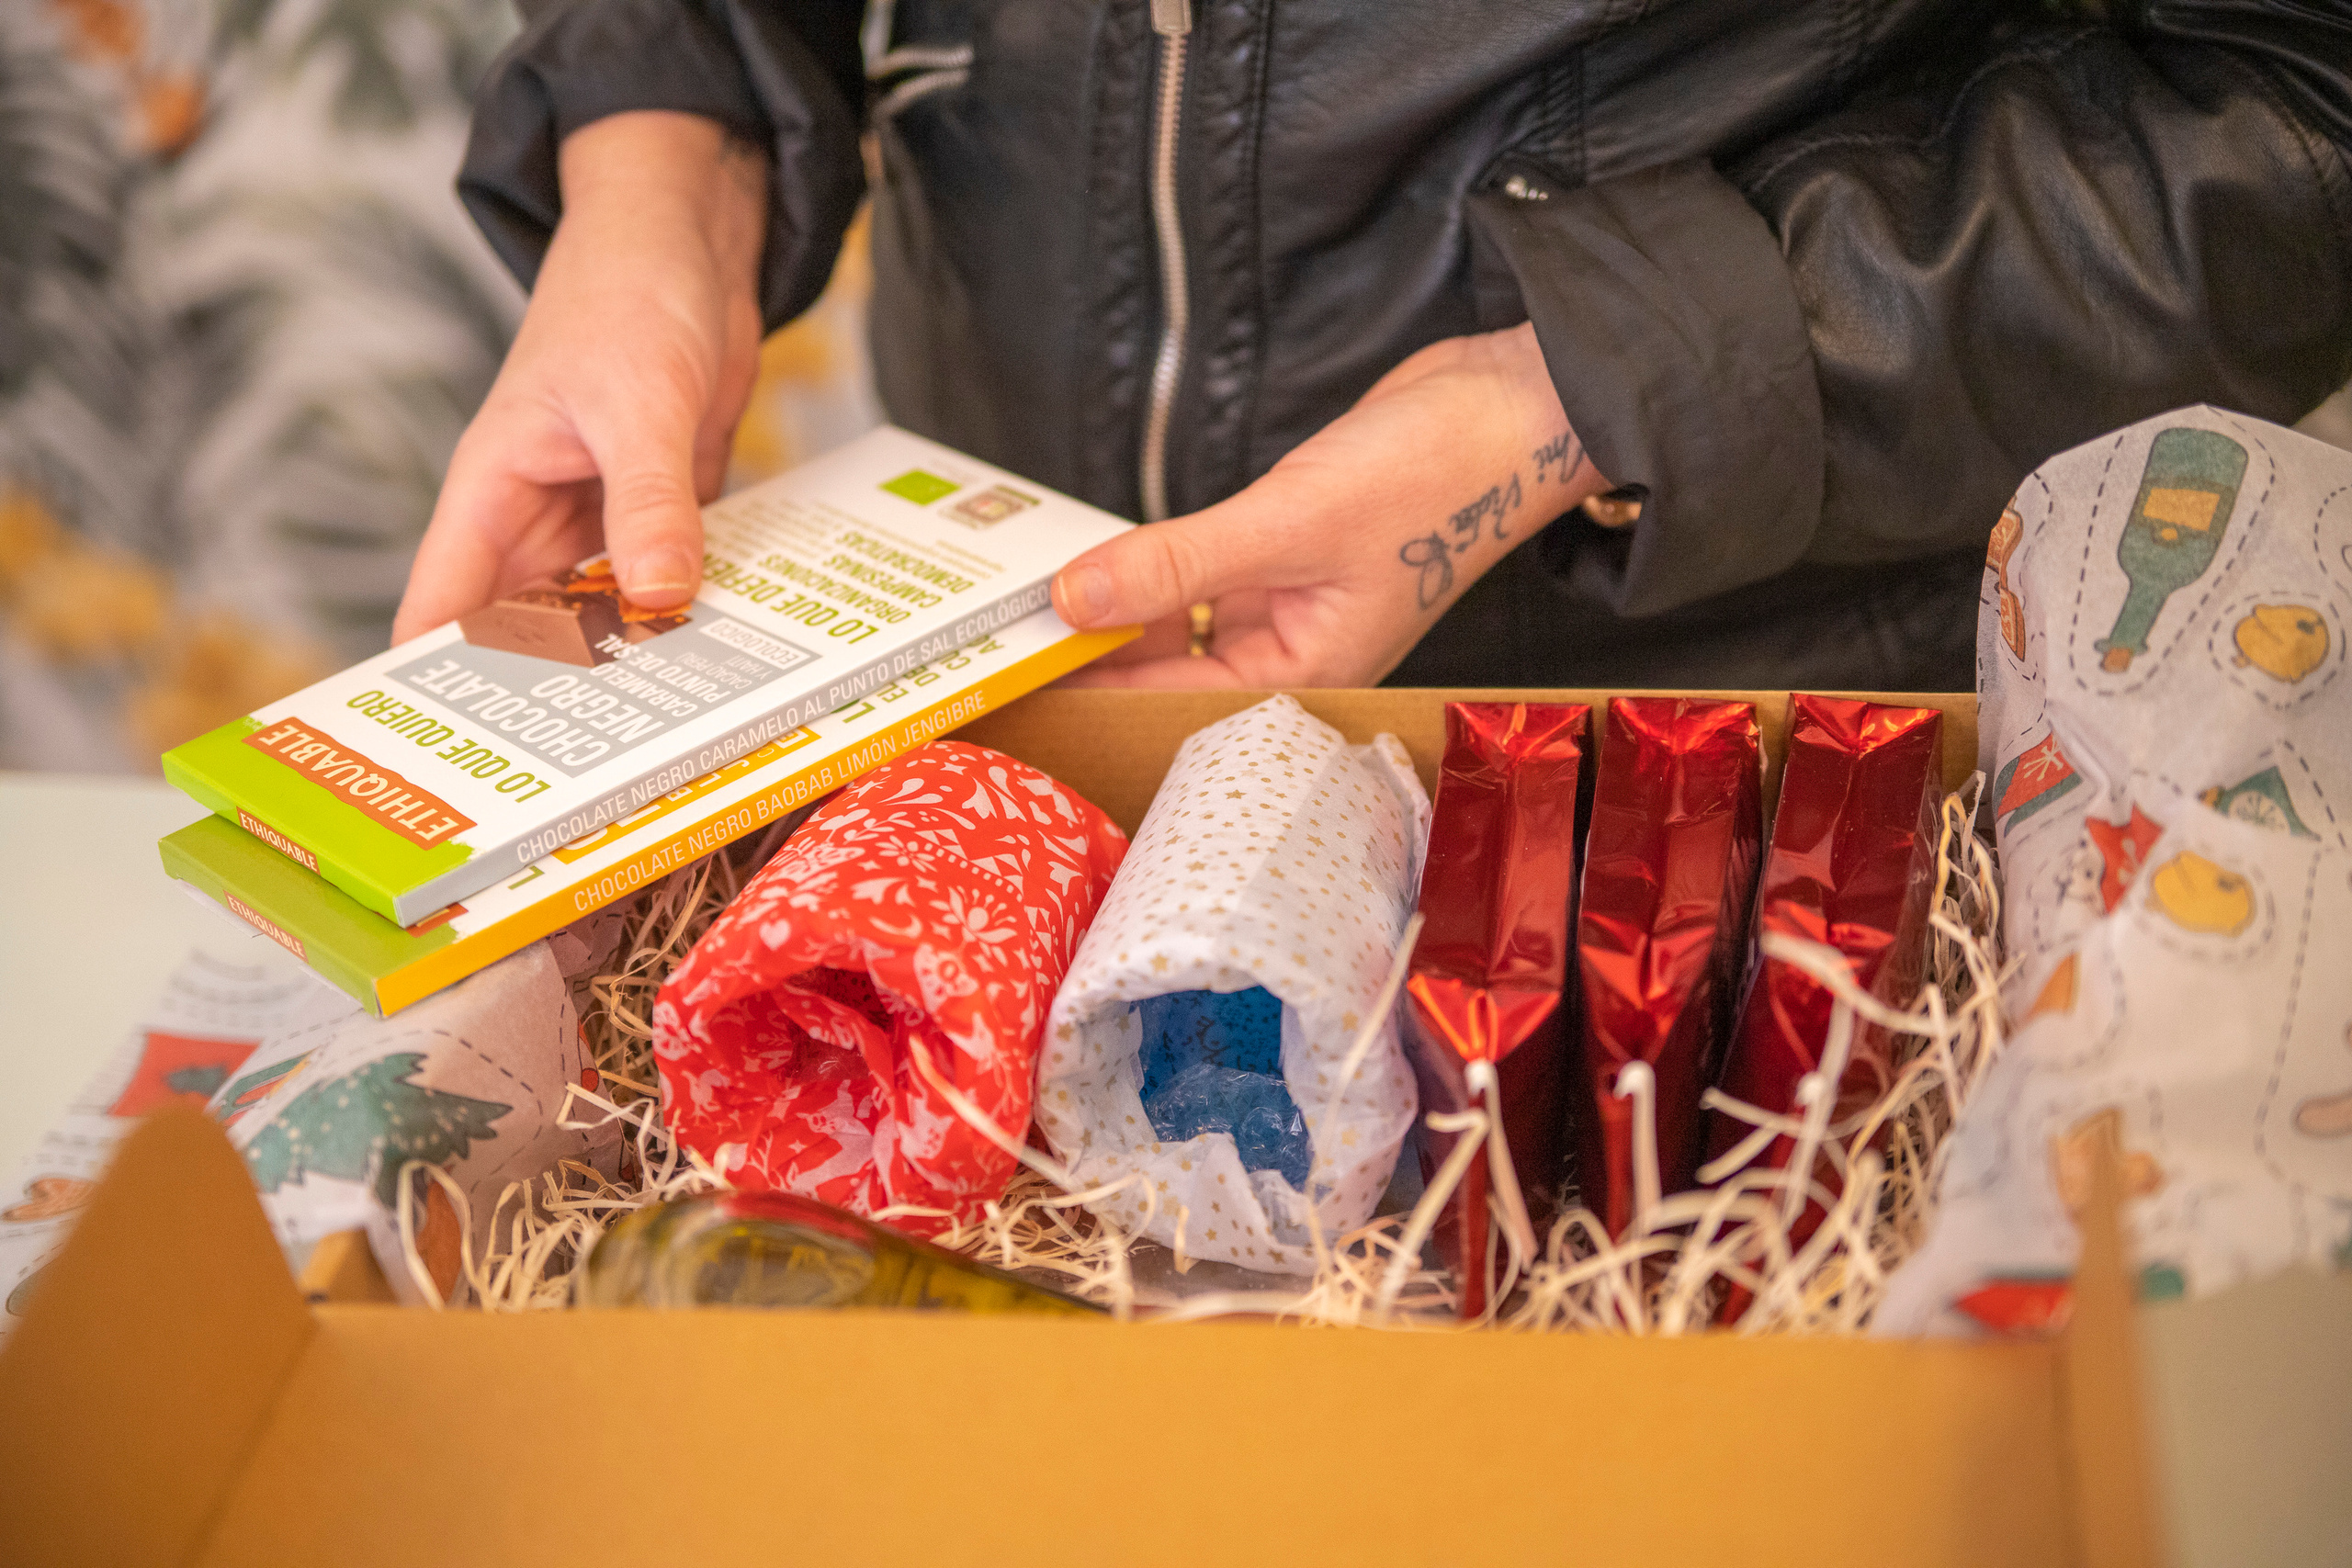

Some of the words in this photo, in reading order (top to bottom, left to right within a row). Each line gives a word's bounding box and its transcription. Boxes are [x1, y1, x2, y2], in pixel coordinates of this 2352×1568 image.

[758, 553, 911, 624] ORGANIZACIONES
[769, 593, 840, 626] QUE
[822, 553, 944, 609] CAMPESINAS
[594, 633, 639, 660] SAL
[827, 619, 880, 645] LO
[589, 661, 698, 718] CARAMELO
[628, 651, 668, 672] DE
[655, 664, 731, 704] PUNTO
[705, 663, 752, 690] CACAO
[345, 690, 456, 748] QUIERO
[408, 659, 611, 767] CHOCOLATE
[516, 793, 628, 863] CHOCOLATE
[630, 759, 695, 806] NEGRO
[699, 707, 798, 771] CARAMELO
[804, 694, 827, 720] AL
[829, 661, 888, 705] PUNTO
[893, 647, 917, 676] DE
[920, 633, 954, 661] SAL
[956, 583, 1049, 643] ECOLÓGICO
[529, 674, 665, 745] NEGRO
[258, 724, 459, 840] ETHIQUABLE
[435, 738, 511, 779] QUE
[494, 773, 552, 804] LO
[573, 841, 685, 911] CHOCOLATE
[687, 807, 752, 855] NEGRO
[755, 768, 832, 819] BAOBAB
[837, 735, 897, 778] LIMÓN
[901, 690, 986, 748] JENGIBRE
[240, 812, 318, 872] ETHIQUABLE
[227, 895, 305, 958] ETHIQUABLE
